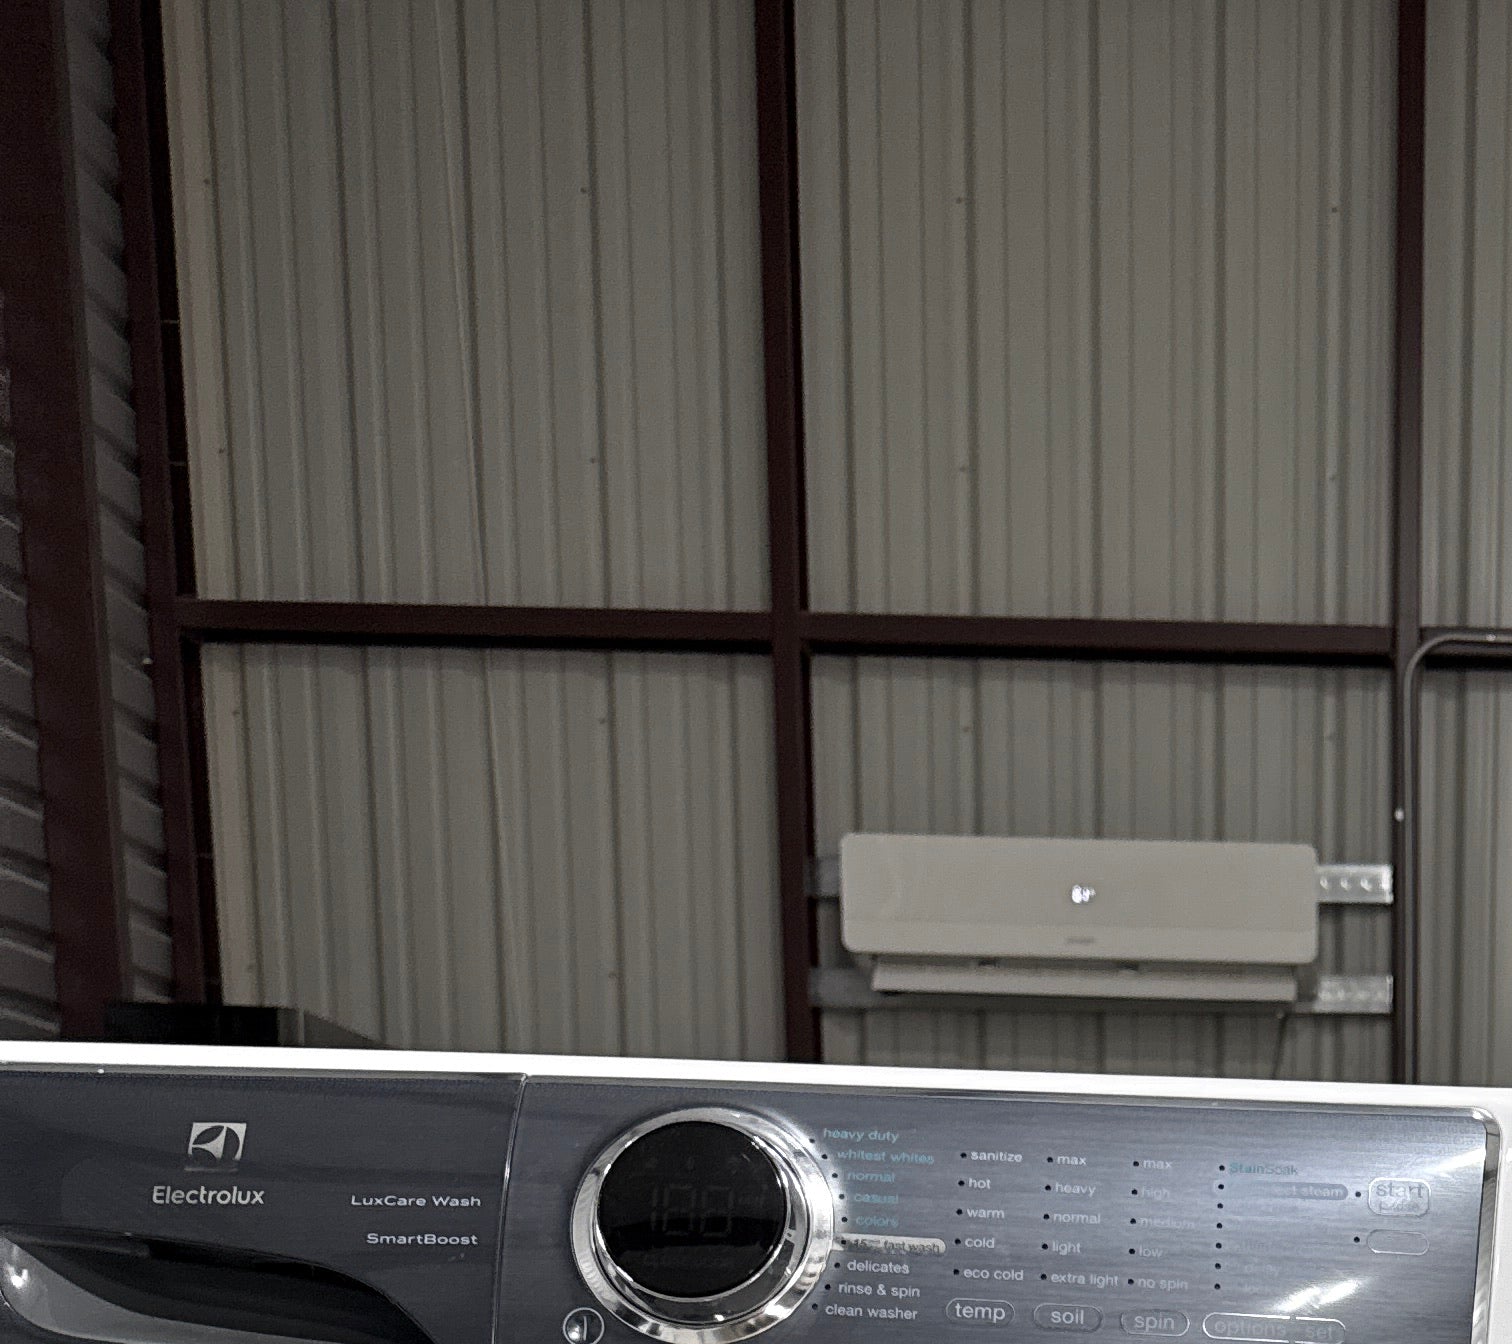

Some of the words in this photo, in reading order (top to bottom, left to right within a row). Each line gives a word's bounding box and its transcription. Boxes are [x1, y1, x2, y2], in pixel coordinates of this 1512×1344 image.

[823, 1128, 864, 1142] heavy
[868, 1130, 898, 1143] duty
[838, 1149, 886, 1161] whitest
[891, 1152, 934, 1165] whites
[971, 1151, 1023, 1162] sanitize
[1057, 1155, 1087, 1165] max
[1143, 1159, 1173, 1169] max
[847, 1172, 895, 1182] normal
[968, 1177, 991, 1189] hot
[152, 1185, 265, 1206] Electrolux
[1055, 1182, 1096, 1197] heavy
[1142, 1186, 1170, 1200] high
[1376, 1182, 1424, 1198] start
[351, 1195, 426, 1206] LuxCare
[432, 1196, 481, 1207] Wash
[855, 1194, 898, 1204] casual
[967, 1208, 1005, 1218] warm
[1053, 1213, 1100, 1225] normal
[856, 1216, 899, 1227] colors
[1140, 1217, 1195, 1229] medium
[366, 1233, 478, 1245] SmartBoost
[965, 1237, 995, 1249] cold
[1052, 1241, 1081, 1255] light
[1139, 1245, 1163, 1257] low
[847, 1260, 910, 1274] delicates
[963, 1269, 990, 1278] eco
[994, 1269, 1024, 1280] cold
[1051, 1272, 1085, 1285] extra
[1090, 1274, 1119, 1288] light
[838, 1283, 873, 1295] rinse
[876, 1284, 886, 1296] &
[891, 1285, 920, 1298] spin
[1138, 1279, 1155, 1288] no
[1159, 1279, 1188, 1291] spin
[825, 1304, 863, 1317] clean
[867, 1307, 918, 1320] washer
[955, 1302, 1006, 1324] temp
[1051, 1309, 1084, 1324] soil
[1134, 1311, 1174, 1332] spin
[1215, 1320, 1287, 1337] options
[1305, 1324, 1334, 1339] set
